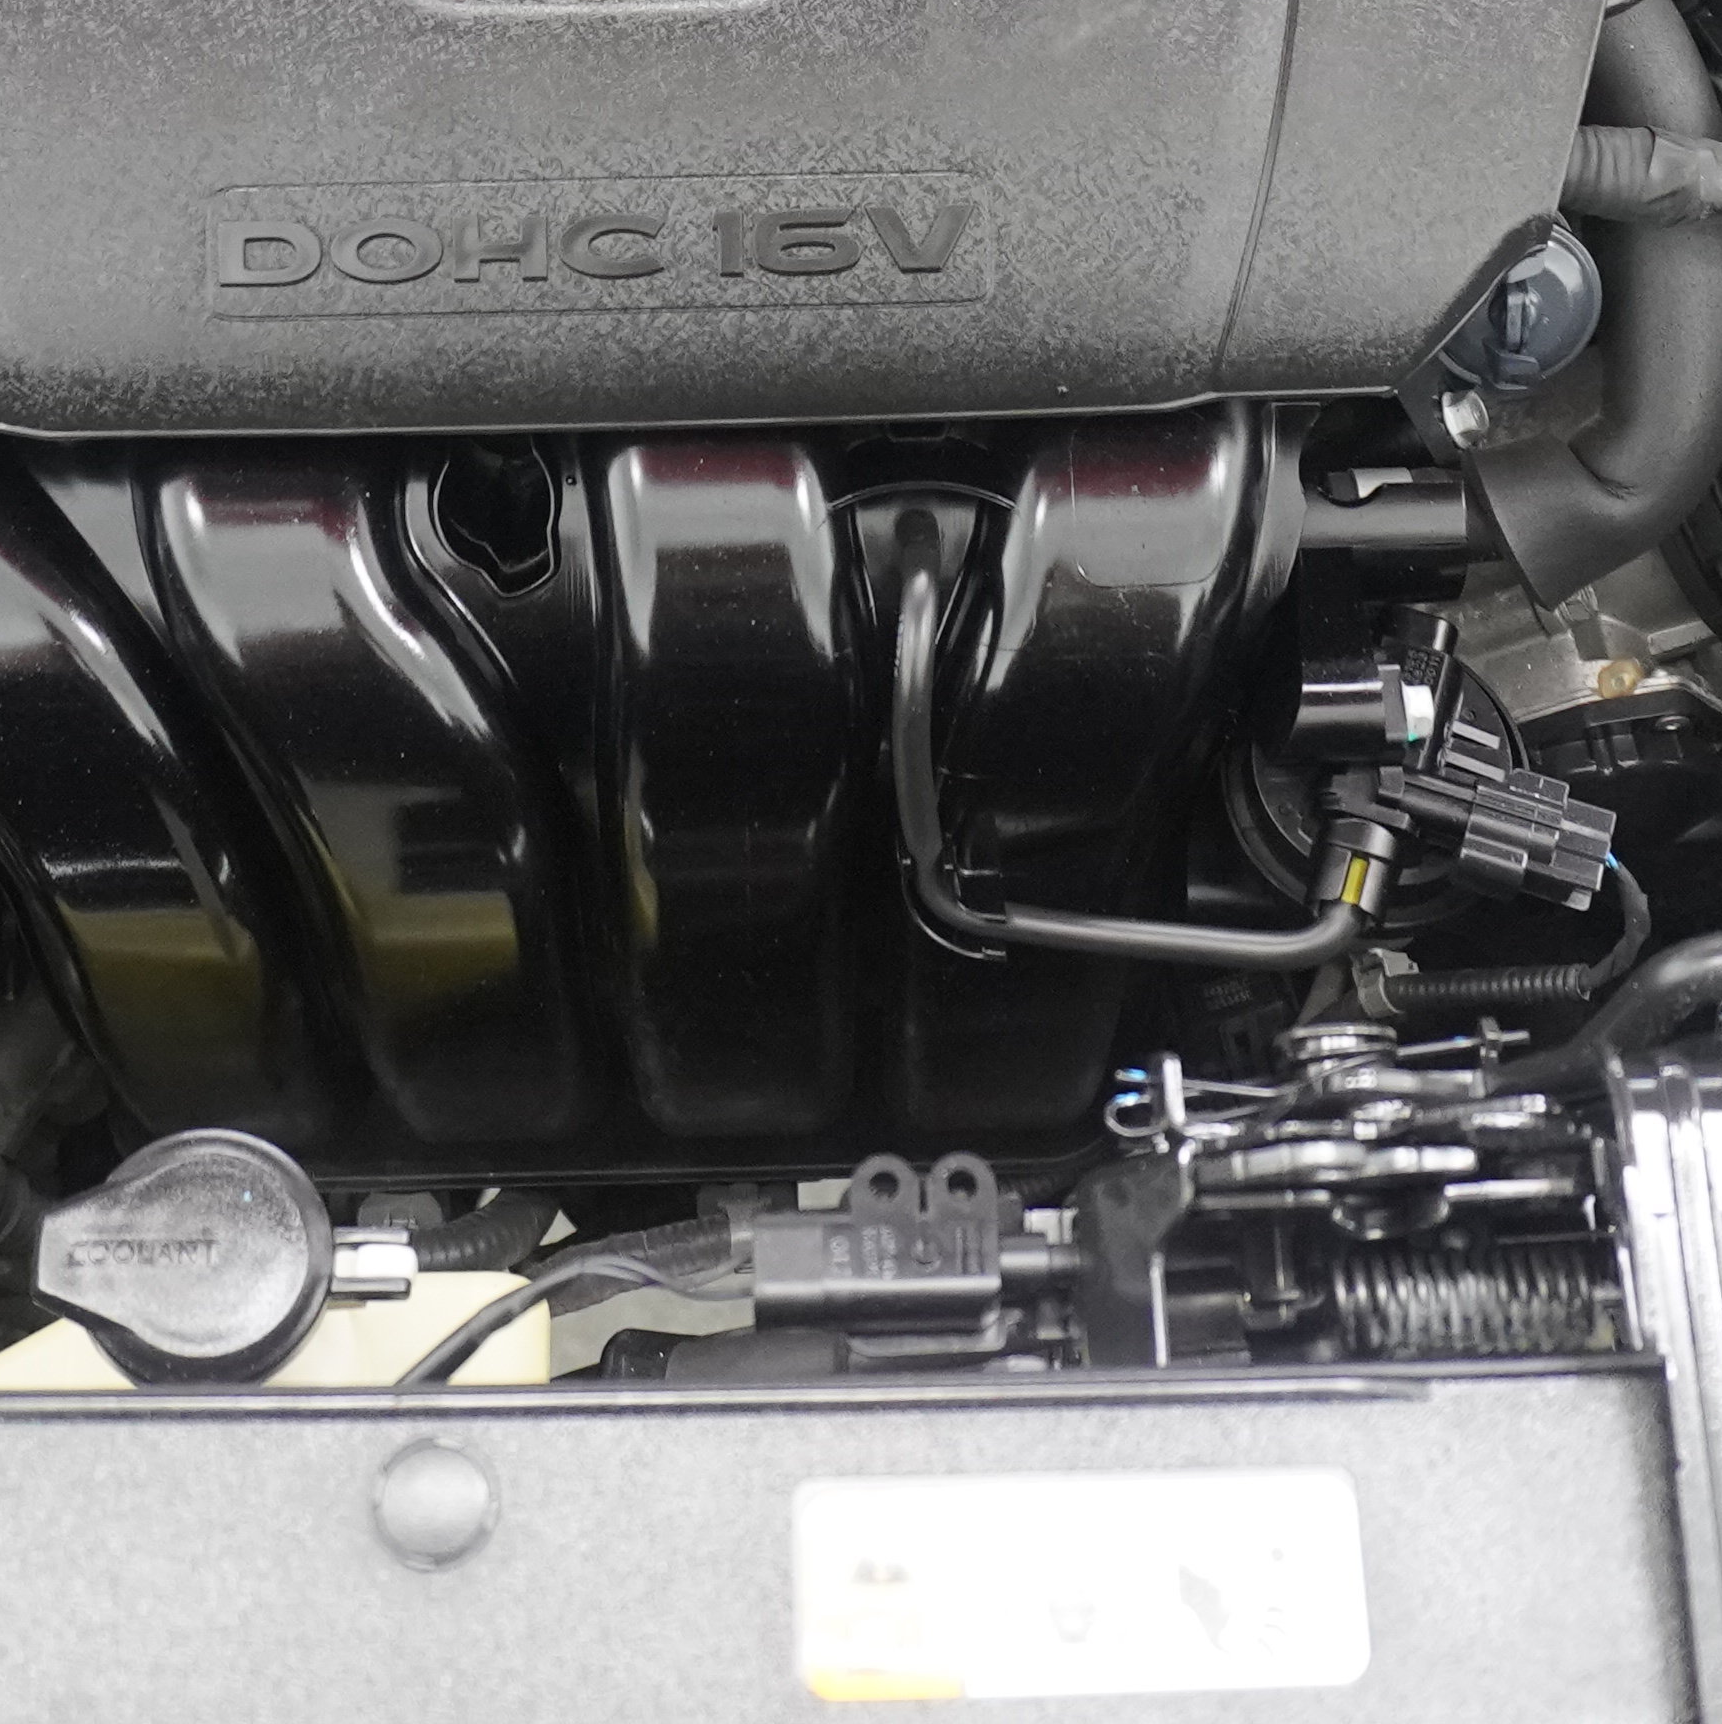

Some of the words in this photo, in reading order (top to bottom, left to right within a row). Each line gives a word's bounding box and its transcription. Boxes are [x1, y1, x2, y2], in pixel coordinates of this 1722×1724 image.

[217, 212, 666, 288] DOHC
[711, 204, 977, 279] 16V
[66, 1238, 219, 1269] COOLANT
